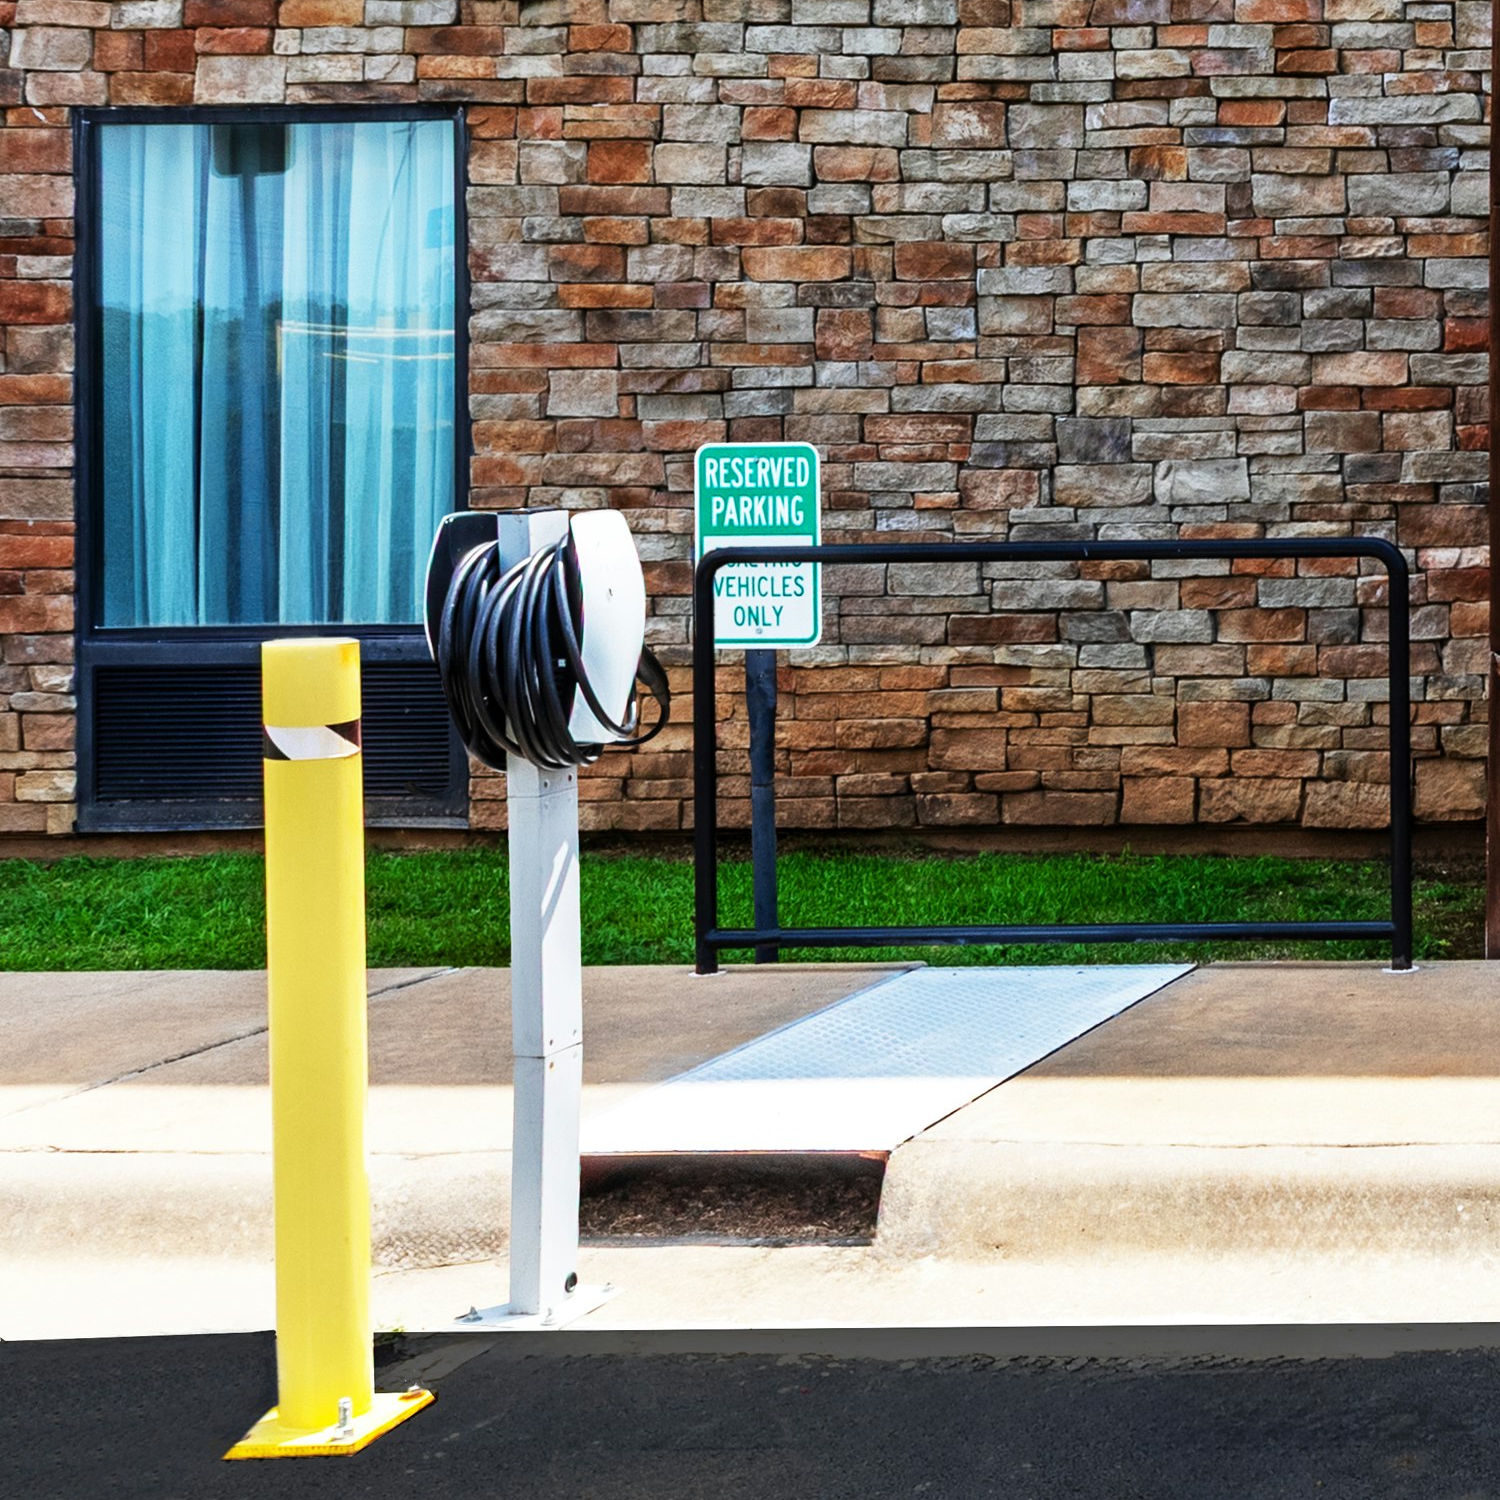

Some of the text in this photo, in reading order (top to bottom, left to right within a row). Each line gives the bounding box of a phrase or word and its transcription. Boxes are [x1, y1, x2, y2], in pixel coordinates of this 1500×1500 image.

[705, 457, 810, 488] RESERVED
[711, 495, 805, 527] PARKING
[713, 576, 805, 597] VEHICLES
[734, 605, 784, 626] ONLY
